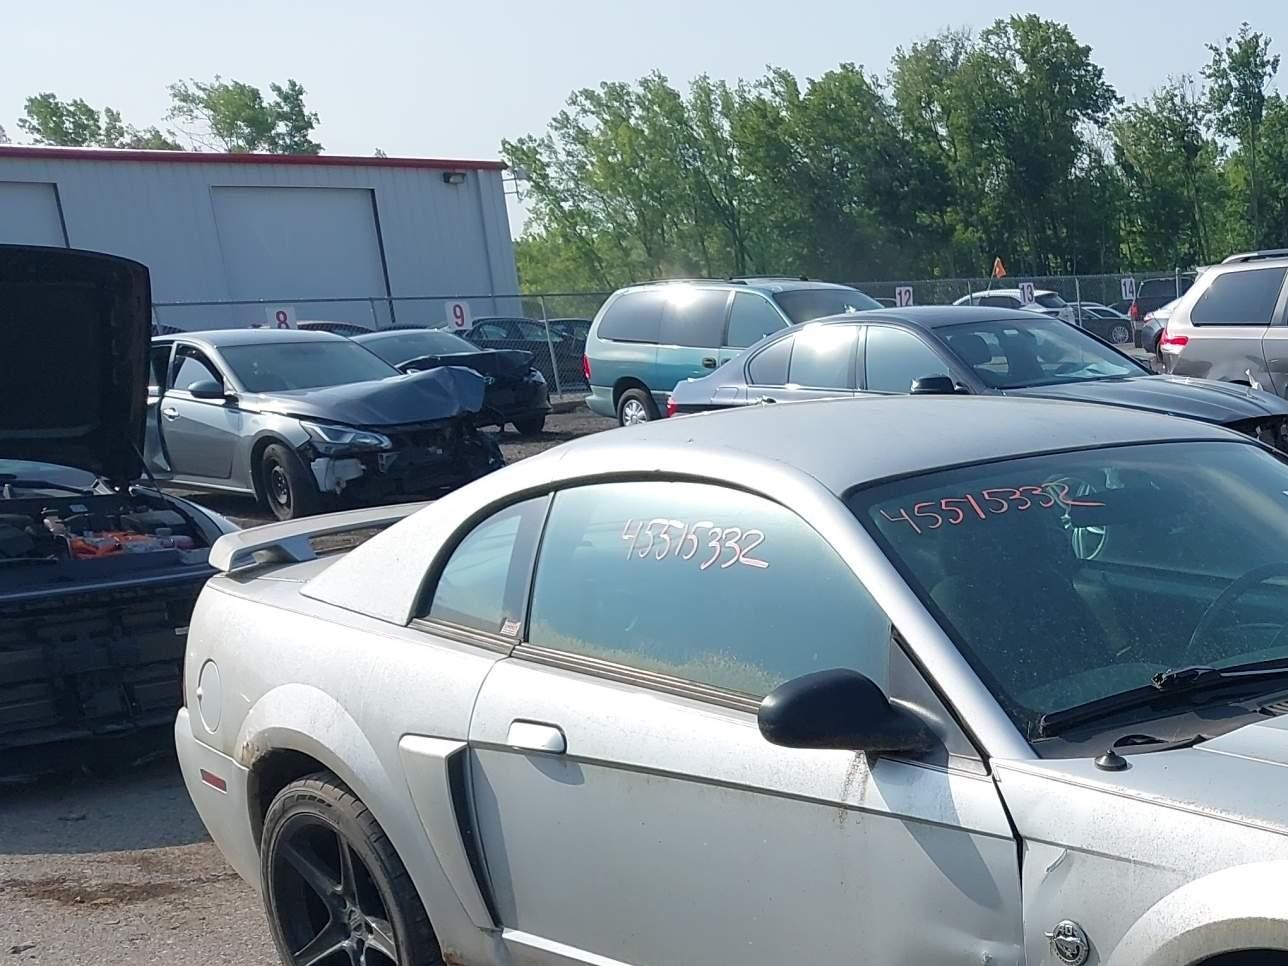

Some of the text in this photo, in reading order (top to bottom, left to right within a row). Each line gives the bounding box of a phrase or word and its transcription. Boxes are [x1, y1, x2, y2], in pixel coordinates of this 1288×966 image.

[897, 288, 911, 307] 12
[1021, 283, 1034, 303] 13
[275, 310, 290, 329] 8
[452, 304, 465, 327] 9
[880, 483, 1106, 535] 45515332
[622, 518, 769, 570] 45515332
